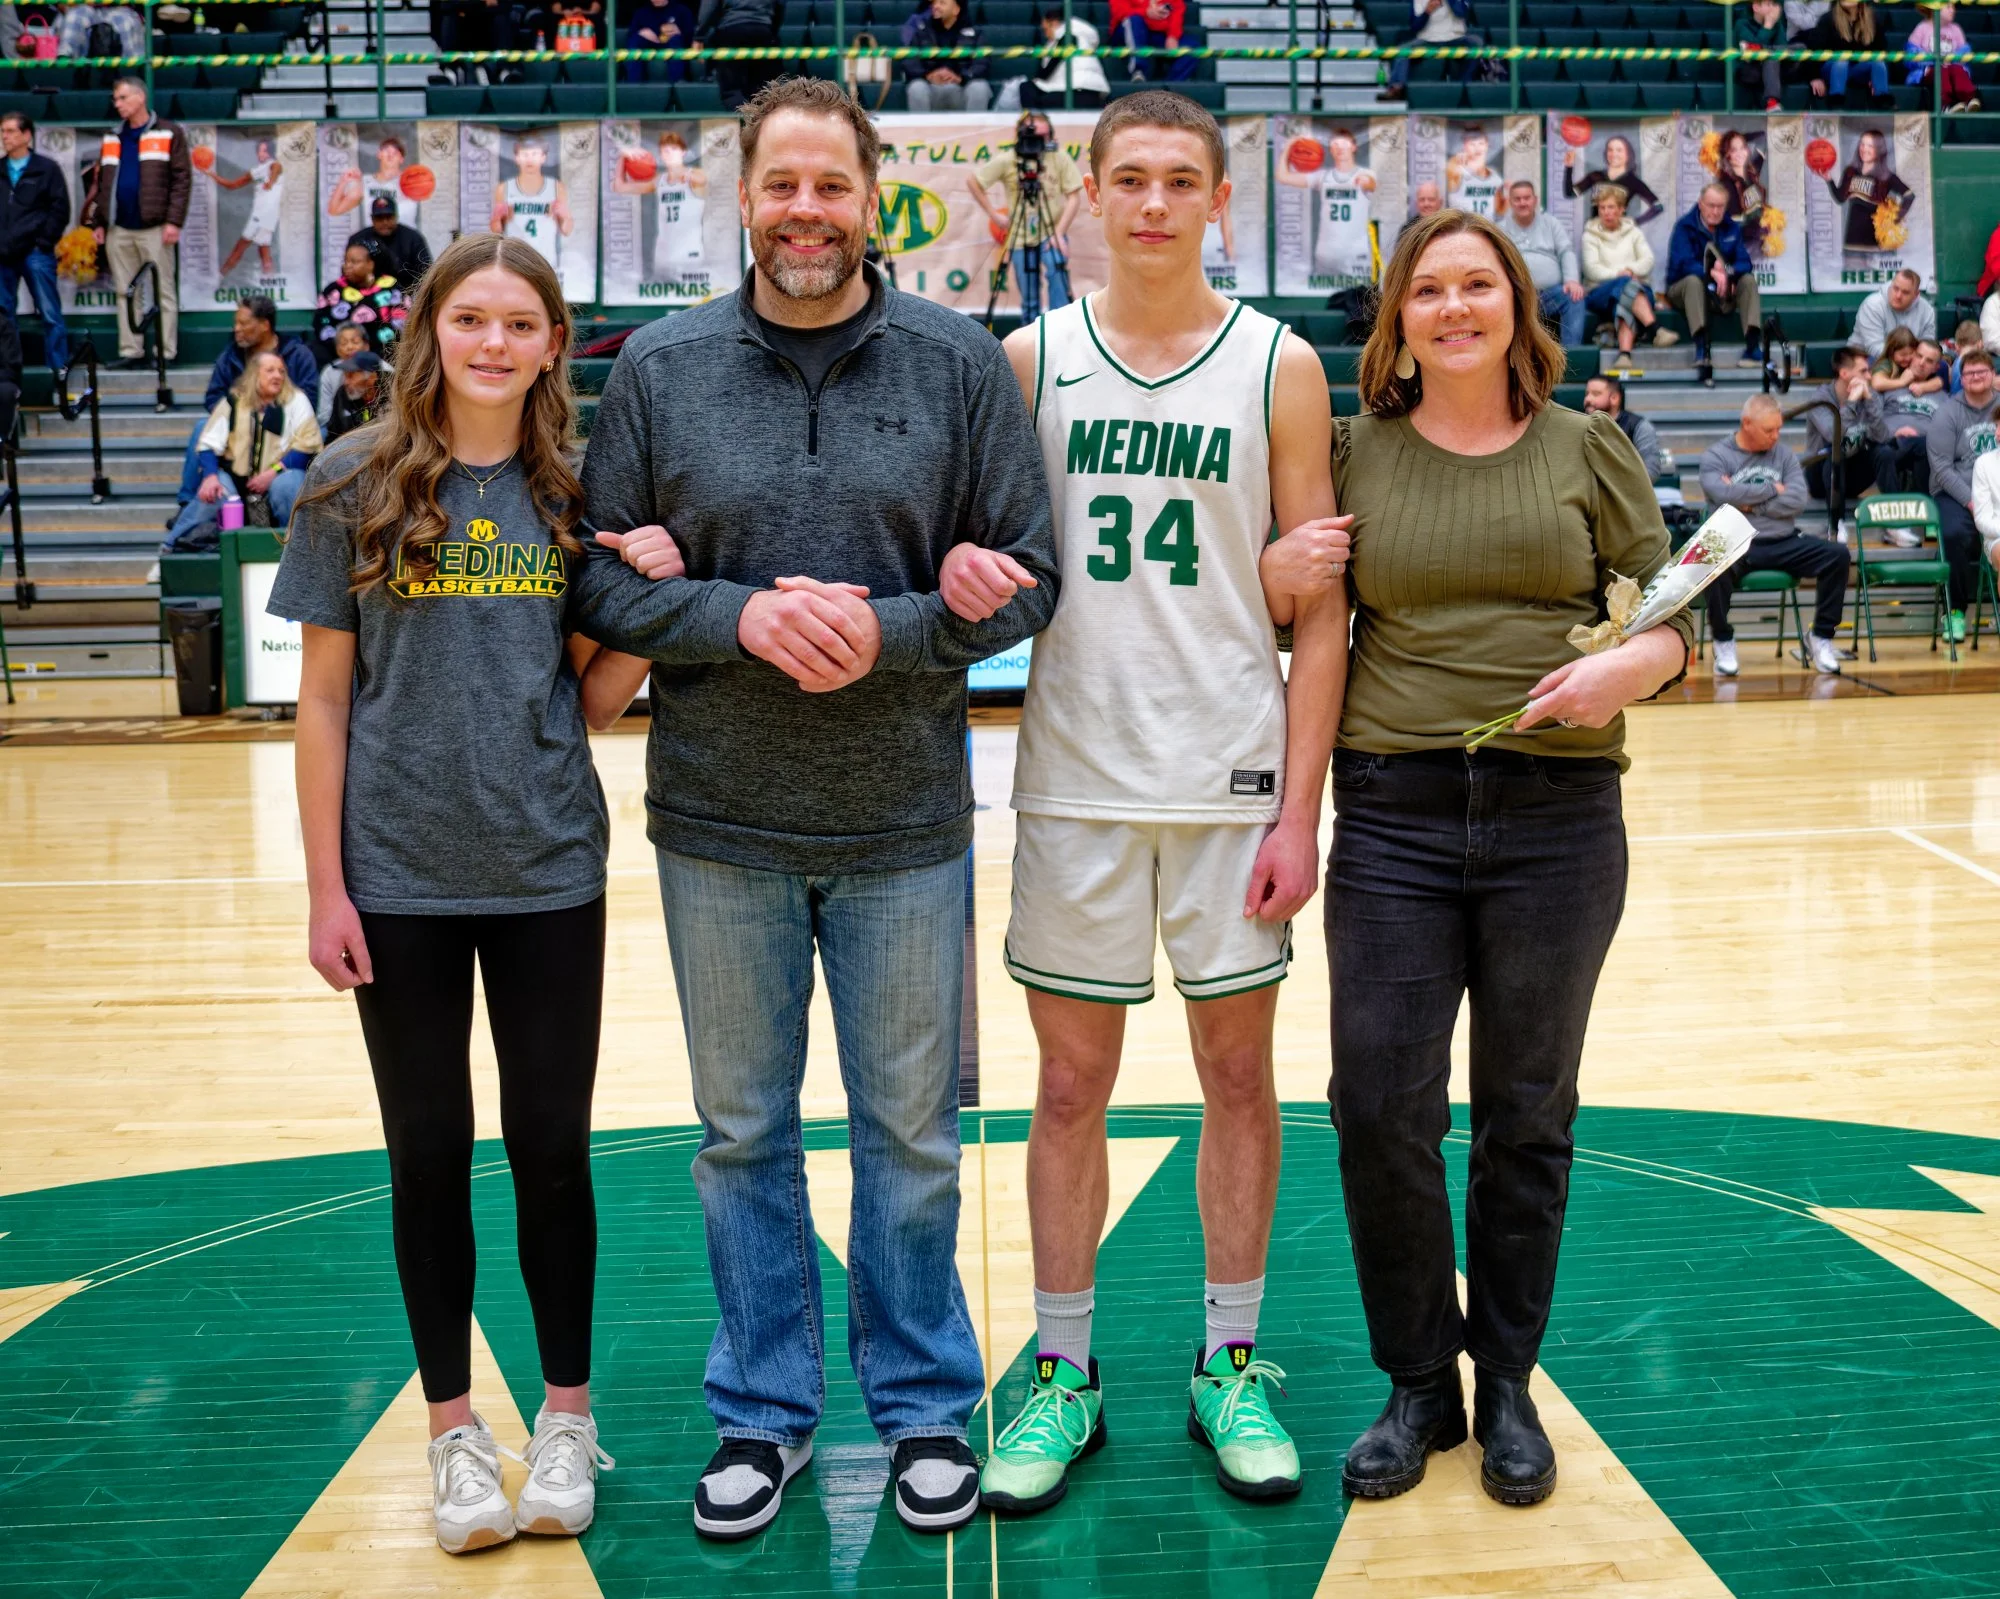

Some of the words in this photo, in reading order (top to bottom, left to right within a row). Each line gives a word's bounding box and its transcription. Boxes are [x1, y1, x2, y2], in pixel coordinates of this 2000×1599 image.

[514, 203, 550, 214] MEDINA
[1330, 204, 1350, 221] 20
[525, 219, 537, 237] 4
[1880, 261, 1902, 269] AVERY
[682, 272, 710, 281] BRODY
[1757, 273, 1776, 286] RD
[639, 282, 711, 297] KOPKAS
[1067, 419, 1231, 484] MEDINA
[1867, 500, 1928, 522] MEDINA
[1086, 494, 1199, 587] 34
[408, 580, 558, 595] BASKETBALL
[262, 639, 302, 652] Natio
[1263, 777, 1269, 788] L
